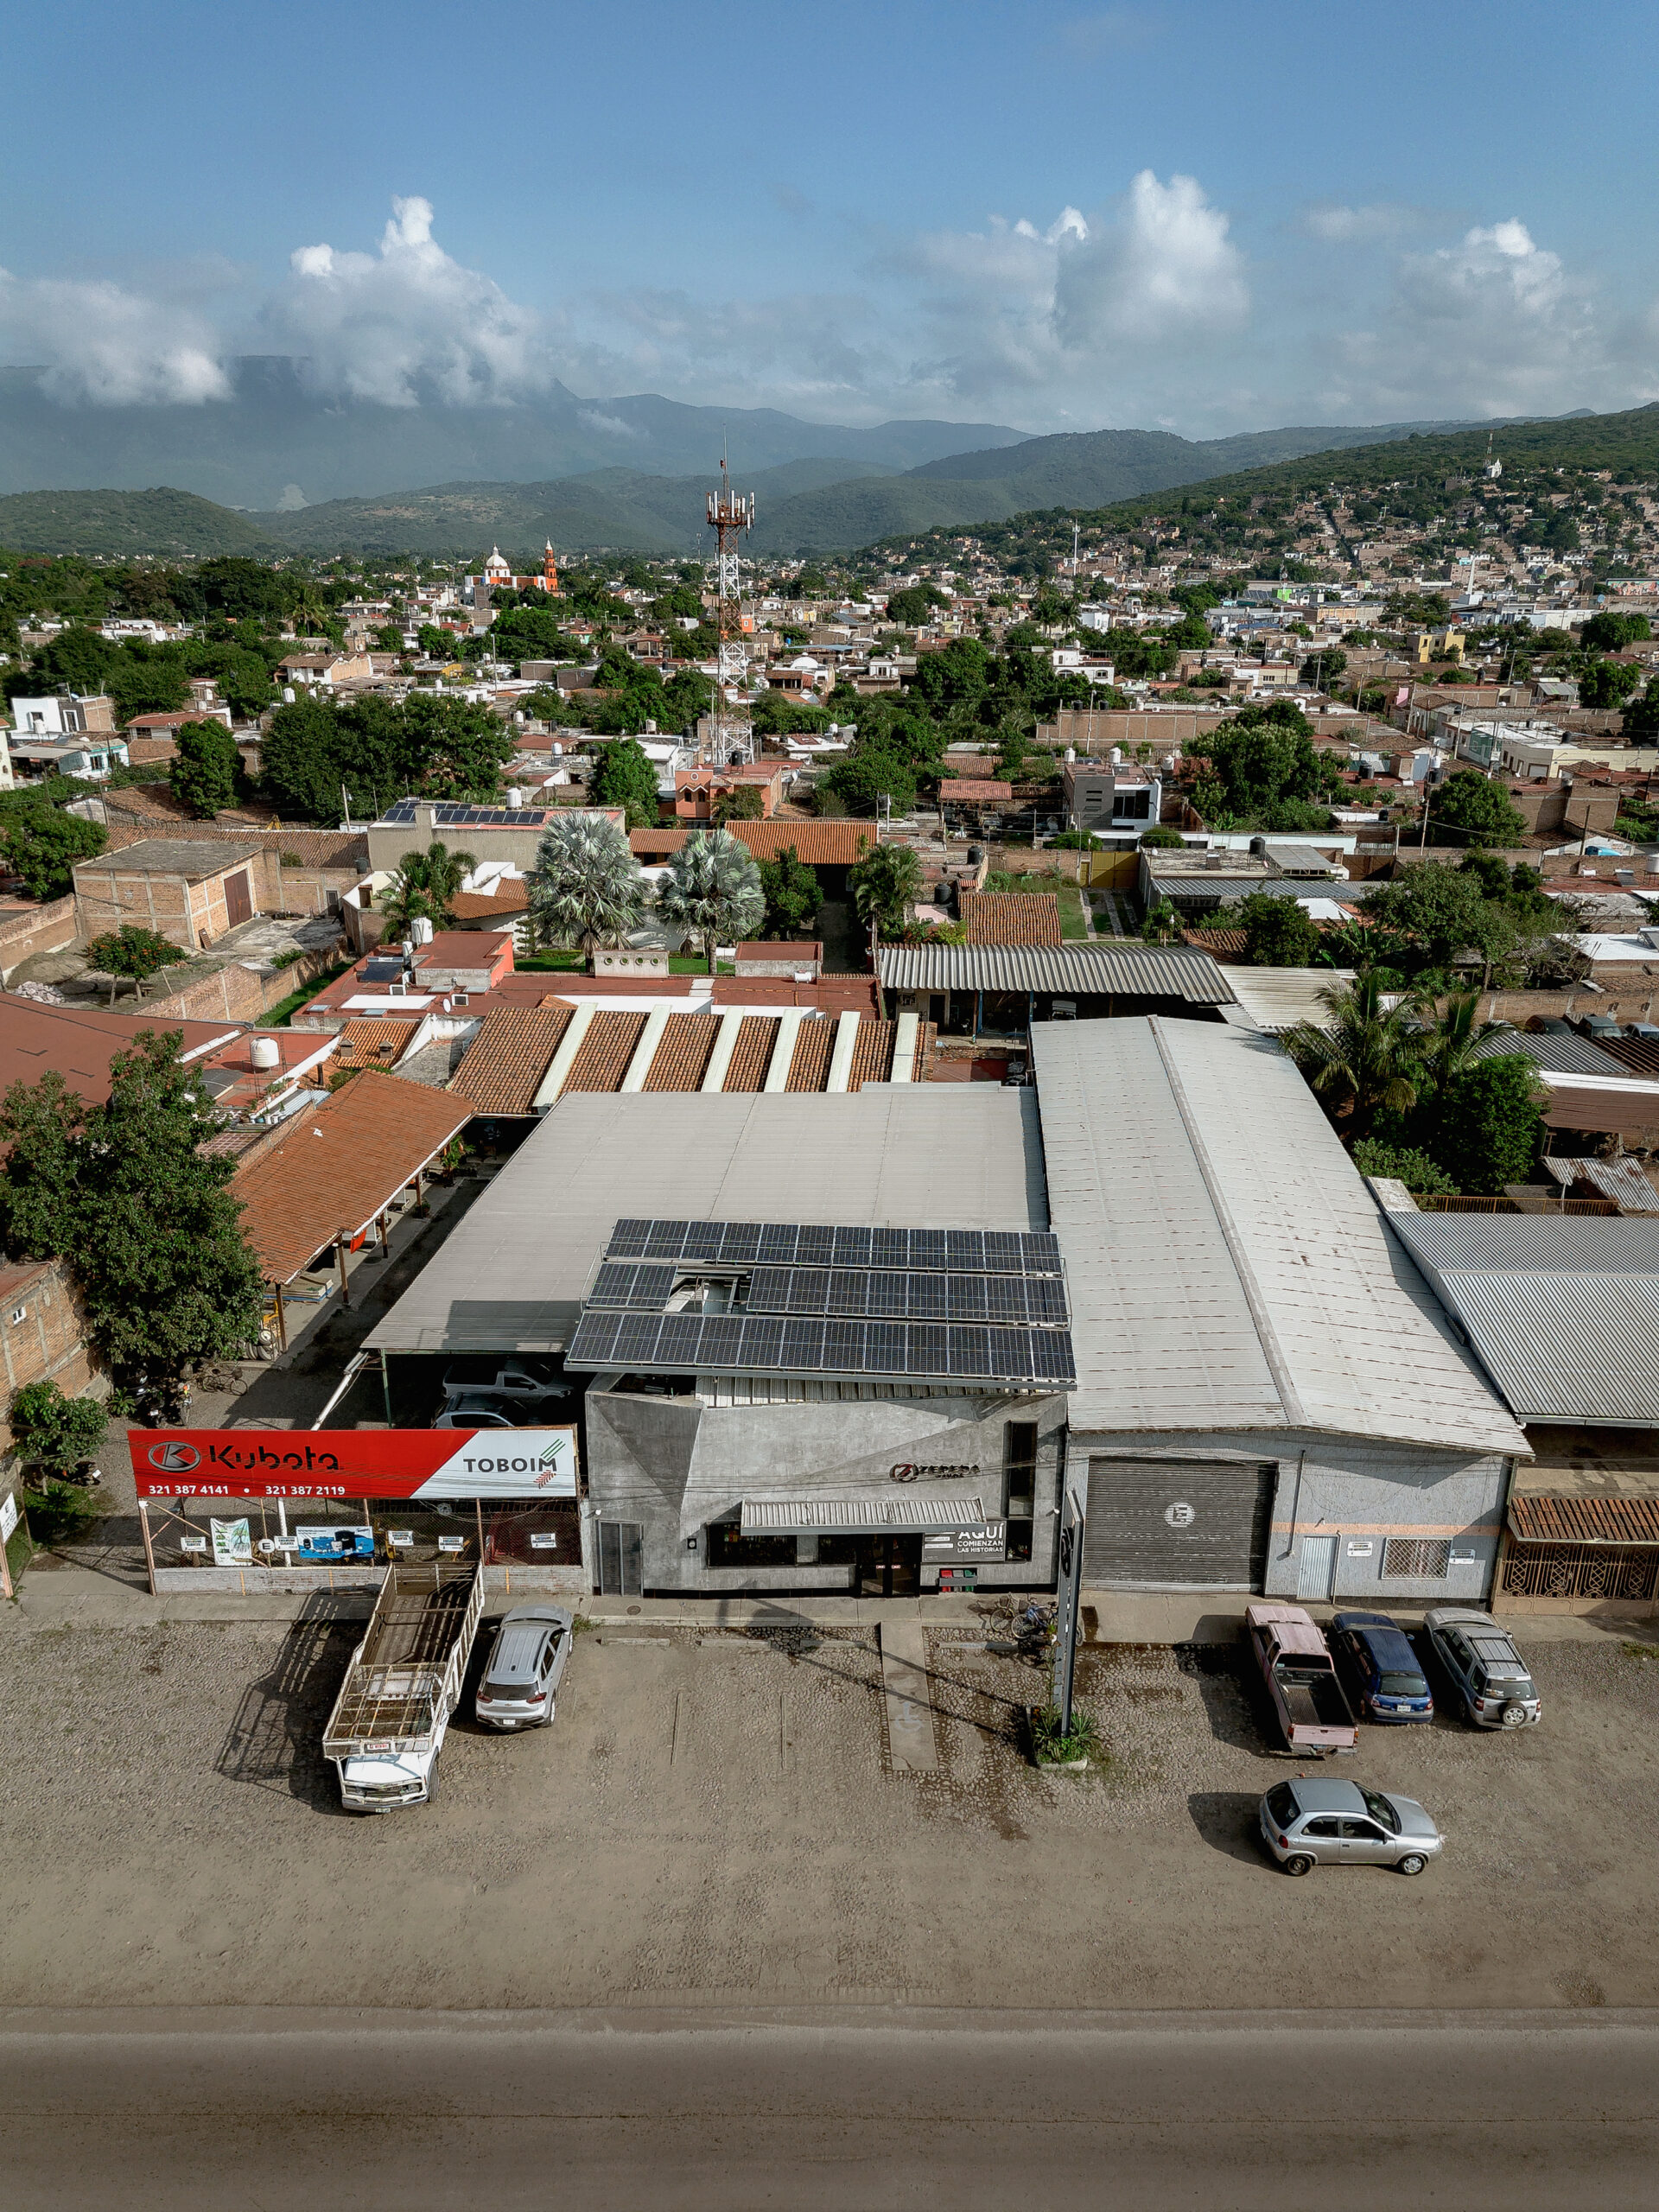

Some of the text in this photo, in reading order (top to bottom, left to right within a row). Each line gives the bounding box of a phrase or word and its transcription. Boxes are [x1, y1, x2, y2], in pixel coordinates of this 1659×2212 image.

[209, 1445, 340, 1471] Kubota
[463, 1458, 557, 1472] TOBOIM
[918, 1465, 981, 1474] ZEPEDA
[149, 1485, 229, 1495] 321 387 4141
[265, 1485, 346, 1496] 321 387 2119
[958, 1522, 1004, 1540] AQUÍ
